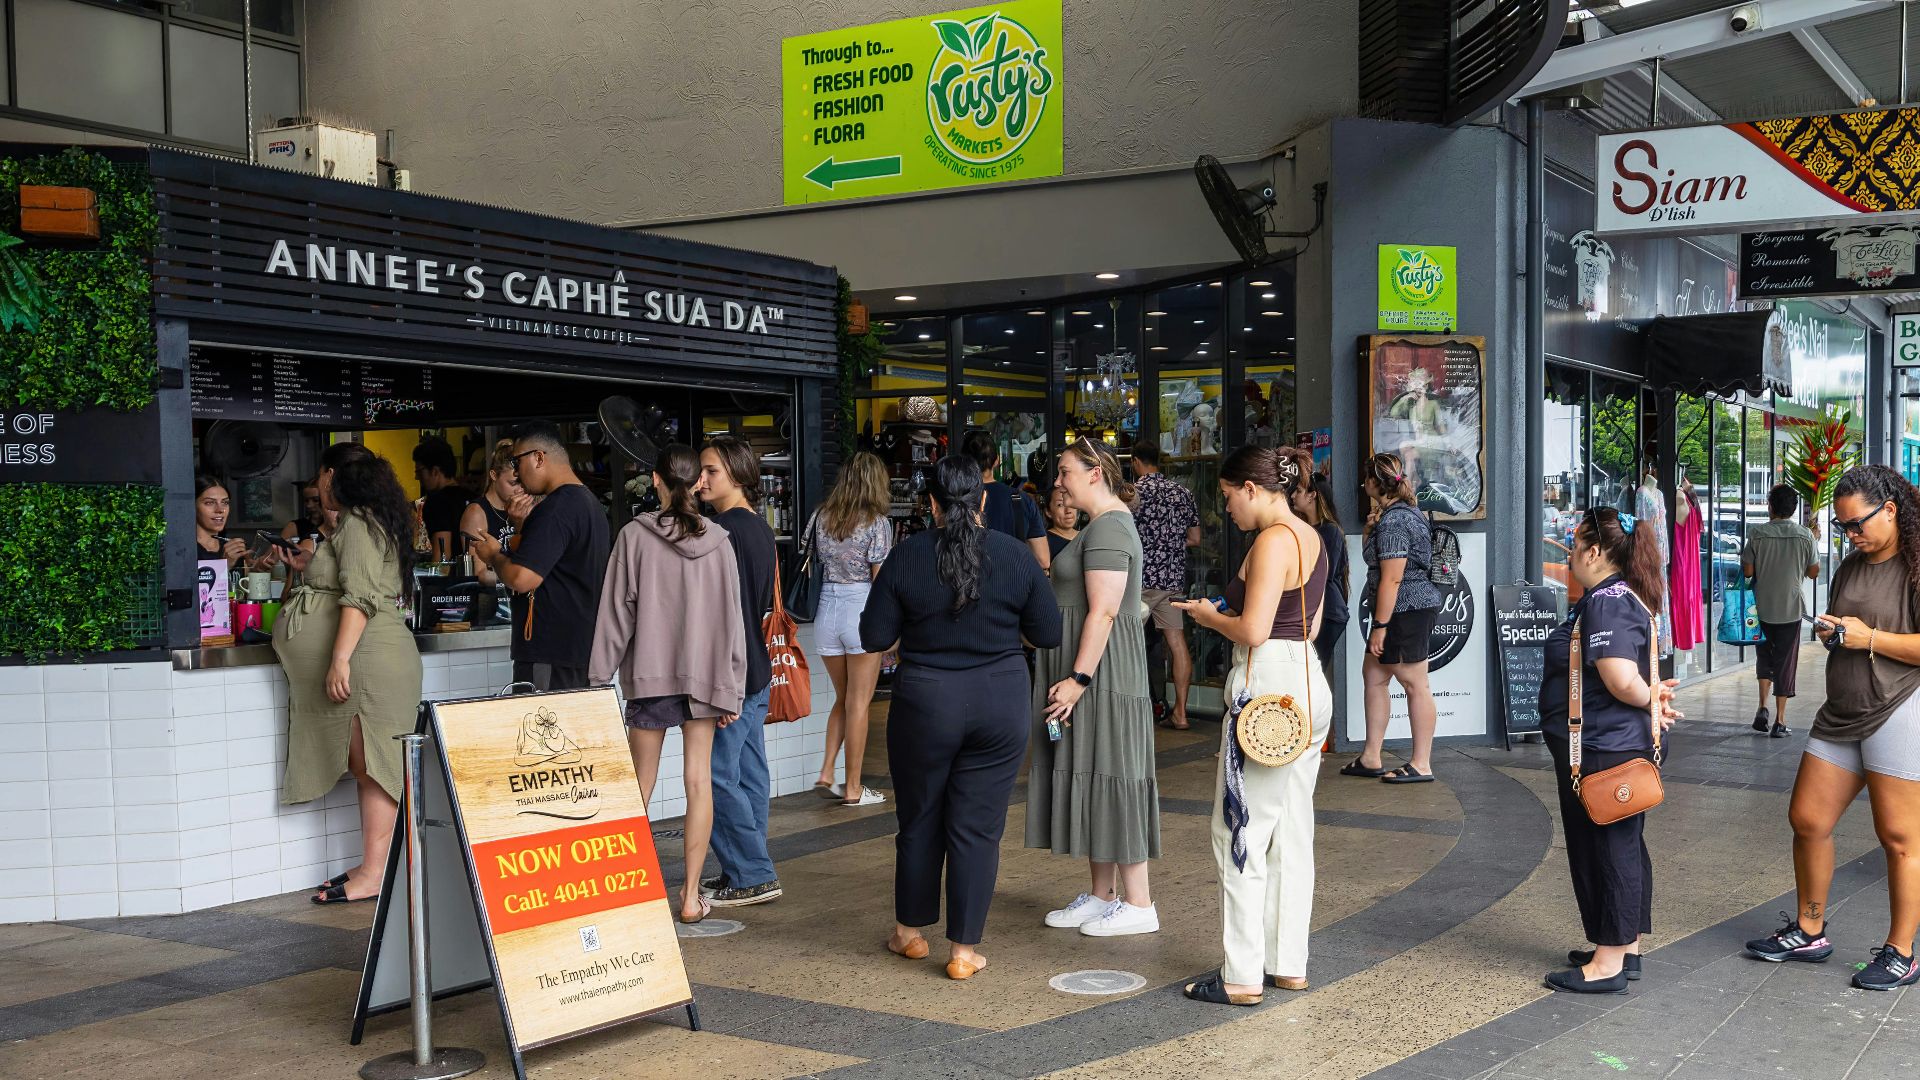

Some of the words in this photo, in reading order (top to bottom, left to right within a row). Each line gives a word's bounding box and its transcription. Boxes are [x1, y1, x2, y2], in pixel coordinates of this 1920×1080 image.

[802, 41, 862, 66] Through
[866, 40, 894, 56] to...
[813, 69, 864, 94] FRESH
[869, 62, 913, 87] FOOD
[930, 31, 1052, 138] rusty's
[813, 93, 884, 120] FASHION
[813, 122, 865, 146] FLORA
[947, 127, 1003, 154] MARKETS
[269, 145, 290, 154] PAK
[924, 135, 967, 177] OPERATING
[969, 166, 997, 179] SINCE
[1000, 153, 1025, 174] 1975
[1612, 139, 1748, 215] Siam
[1649, 205, 1696, 222] D'lish
[1751, 231, 1805, 248] Gorgeous
[1751, 252, 1811, 268] Romantic
[264, 239, 486, 299] ANNEE'S
[502, 269, 631, 317] CAPHÊ
[644, 290, 711, 328] SUA
[1396, 257, 1444, 295] rusty's
[1750, 275, 1816, 290] Irresistible
[488, 317, 578, 337] VIETNAMESE
[585, 328, 633, 344] COFFEE
[1809, 316, 1828, 361] Nail
[1900, 343, 1920, 361] G
[13, 413, 54, 434] OF
[0, 443, 56, 464] ESS
[431, 595, 453, 603] ORDER
[771, 634, 785, 647] All
[1571, 668, 1579, 700] MIMCO
[507, 763, 596, 793] EMPATHY
[516, 797, 534, 807] THAI
[534, 792, 570, 804] MASSAGE
[570, 785, 599, 804] Cairns
[495, 844, 562, 879] NOW
[570, 831, 637, 864] OPEN
[503, 888, 550, 915] Call:
[554, 878, 600, 903] 4041
[604, 868, 649, 893] 0272
[536, 974, 559, 990] The
[560, 960, 609, 985] Empathy
[610, 955, 630, 969] We
[631, 951, 655, 966] Care
[558, 975, 644, 1006] www.thaiempathy.com
